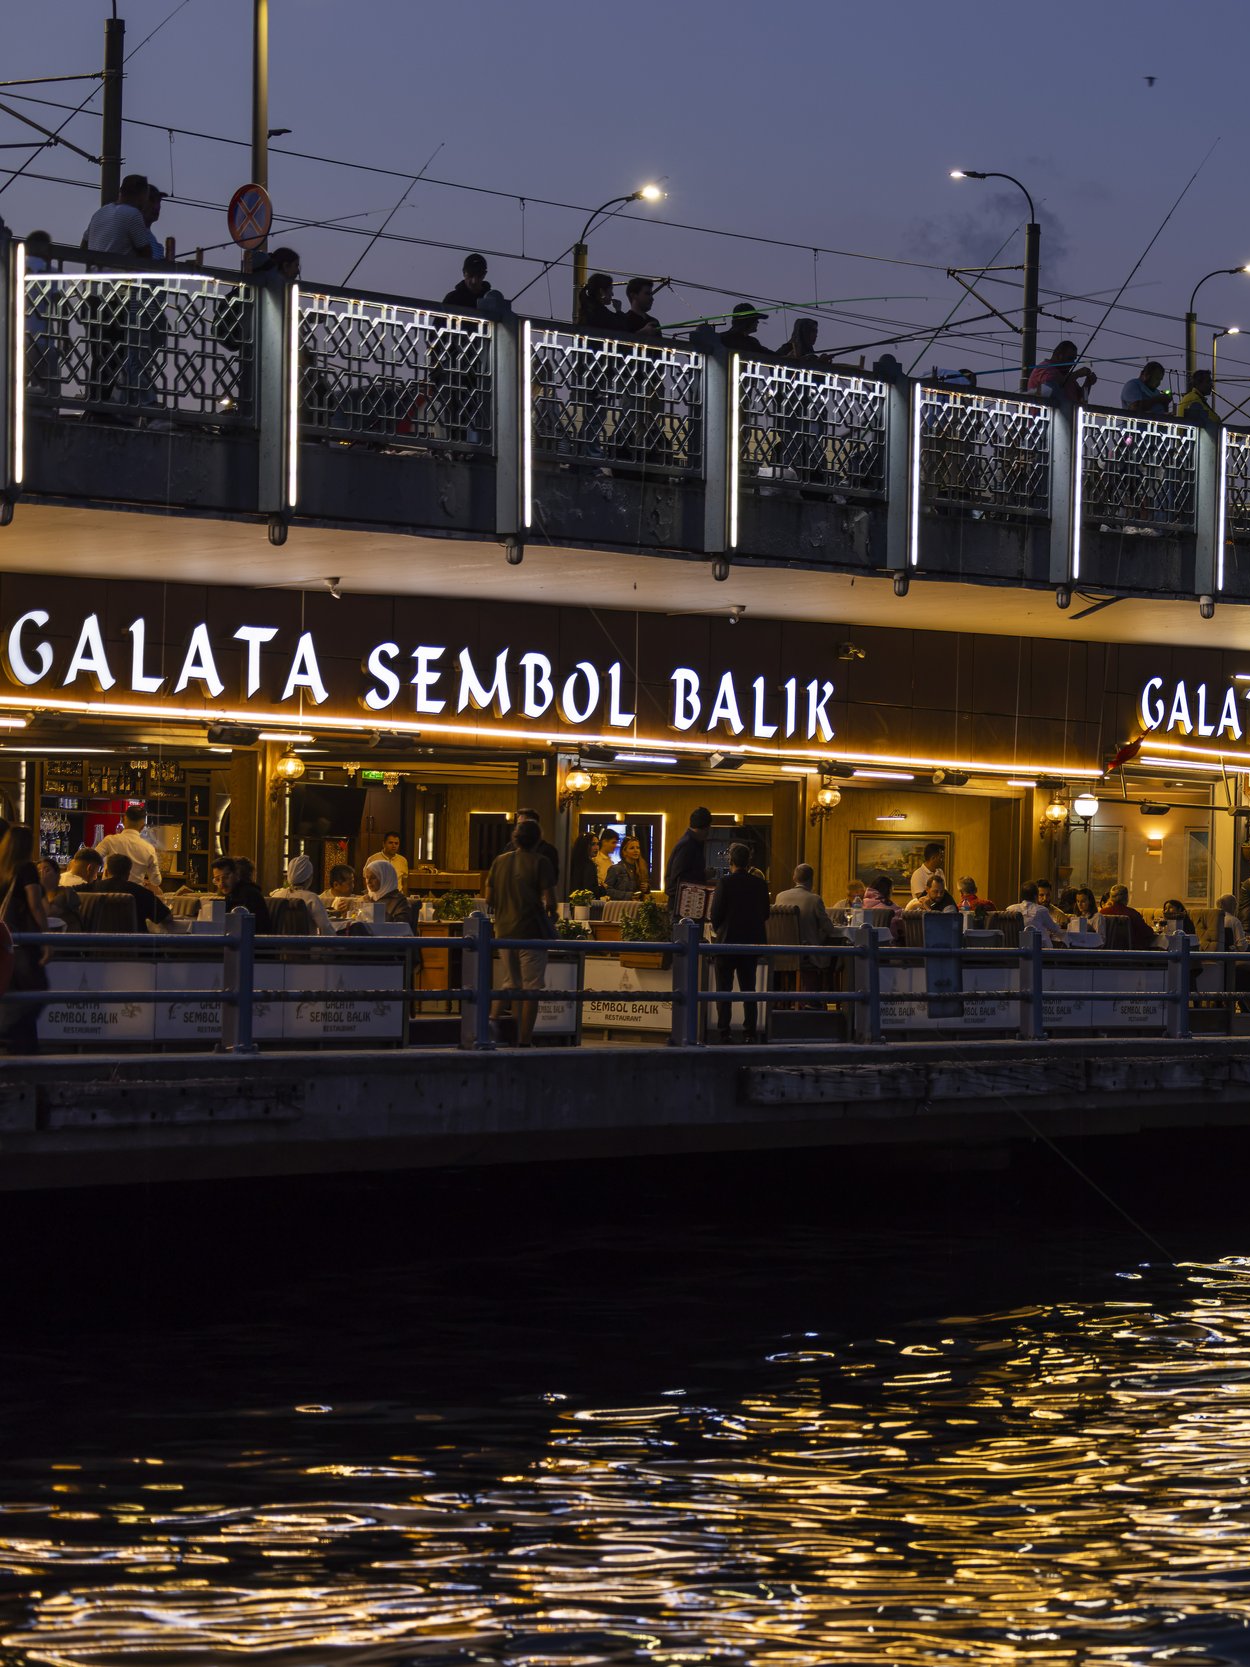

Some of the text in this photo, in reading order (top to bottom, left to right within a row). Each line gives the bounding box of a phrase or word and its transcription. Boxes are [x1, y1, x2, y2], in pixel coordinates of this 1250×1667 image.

[8, 610, 835, 742] GALATA SEMBOL BALIK
[590, 1001, 659, 1014] SEMBOL BALIK
[49, 1011, 118, 1024] SEMBOL BALIK
[183, 1011, 220, 1023] SEMBOL
[310, 1011, 371, 1023] SEMBOL BALIK
[604, 1014, 643, 1022] RESTAURANT
